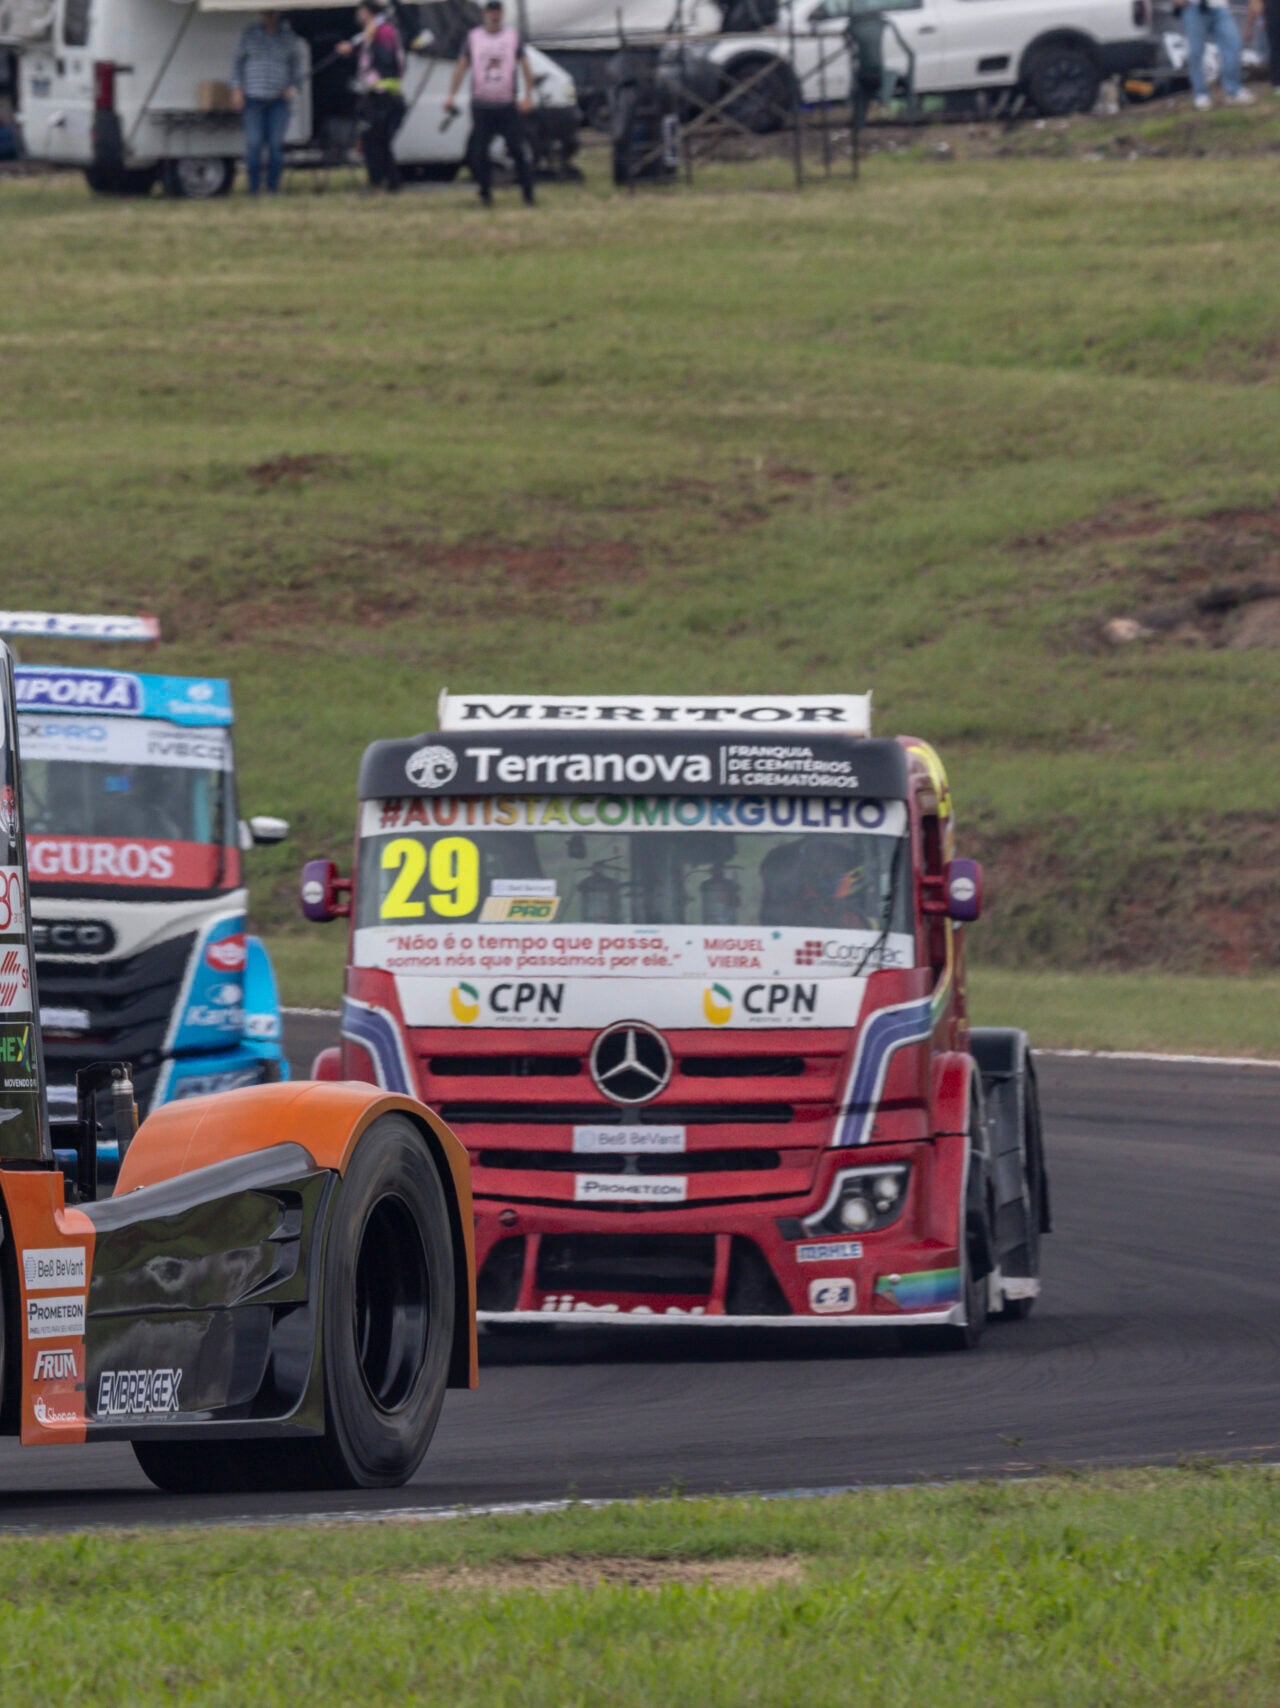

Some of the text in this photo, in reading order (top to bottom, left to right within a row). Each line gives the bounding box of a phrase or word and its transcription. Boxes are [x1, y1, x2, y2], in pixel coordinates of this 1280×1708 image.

[461, 703, 847, 723] MERITOR
[728, 745, 814, 759] FRANQUIA
[465, 747, 712, 783] Terranova
[728, 758, 753, 771] DE
[728, 773, 740, 785] &
[380, 797, 886, 829] #AUTISTACOMORGULHO
[26, 840, 173, 879] GUROS
[380, 836, 480, 919] 29
[508, 905, 551, 918] PRO
[443, 933, 456, 950] é
[460, 938, 473, 950] o
[478, 935, 549, 954] tempo
[552, 937, 593, 955] que
[703, 938, 765, 952] MIGUEL
[386, 955, 441, 967] somos
[445, 952, 476, 967] nós
[480, 955, 512, 970] que
[516, 955, 605, 970] passamos
[610, 955, 638, 970] por
[707, 955, 761, 968] VIEIRA
[489, 982, 565, 1013] CPN
[742, 983, 818, 1014] CPN
[37, 1259, 84, 1278] Be8 BeVant
[28, 1303, 83, 1320] PROMETEON
[33, 1349, 78, 1380] FRUM
[96, 1368, 183, 1415] EMBREAGEX
